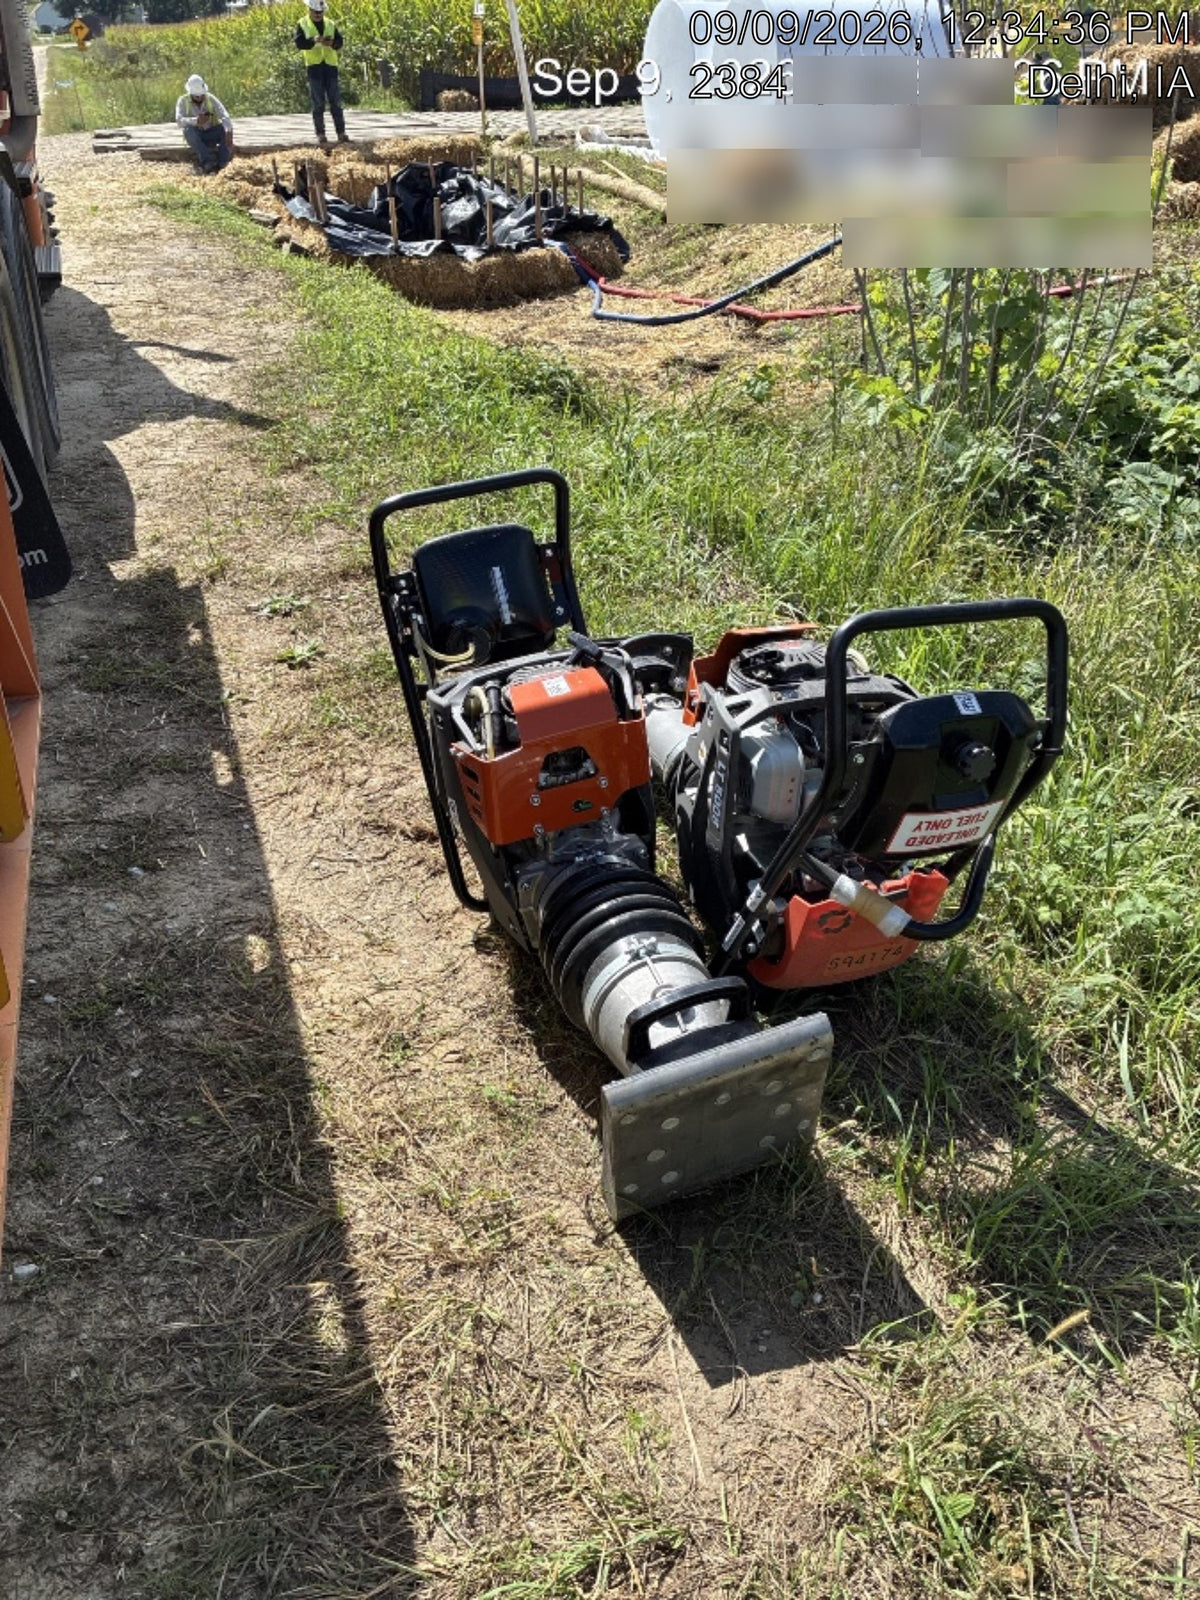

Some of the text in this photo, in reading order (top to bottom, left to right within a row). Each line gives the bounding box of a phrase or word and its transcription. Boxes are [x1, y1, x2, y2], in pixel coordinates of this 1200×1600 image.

[911, 810, 990, 833] FUEL ONLY
[905, 826, 980, 848] UNLEADED
